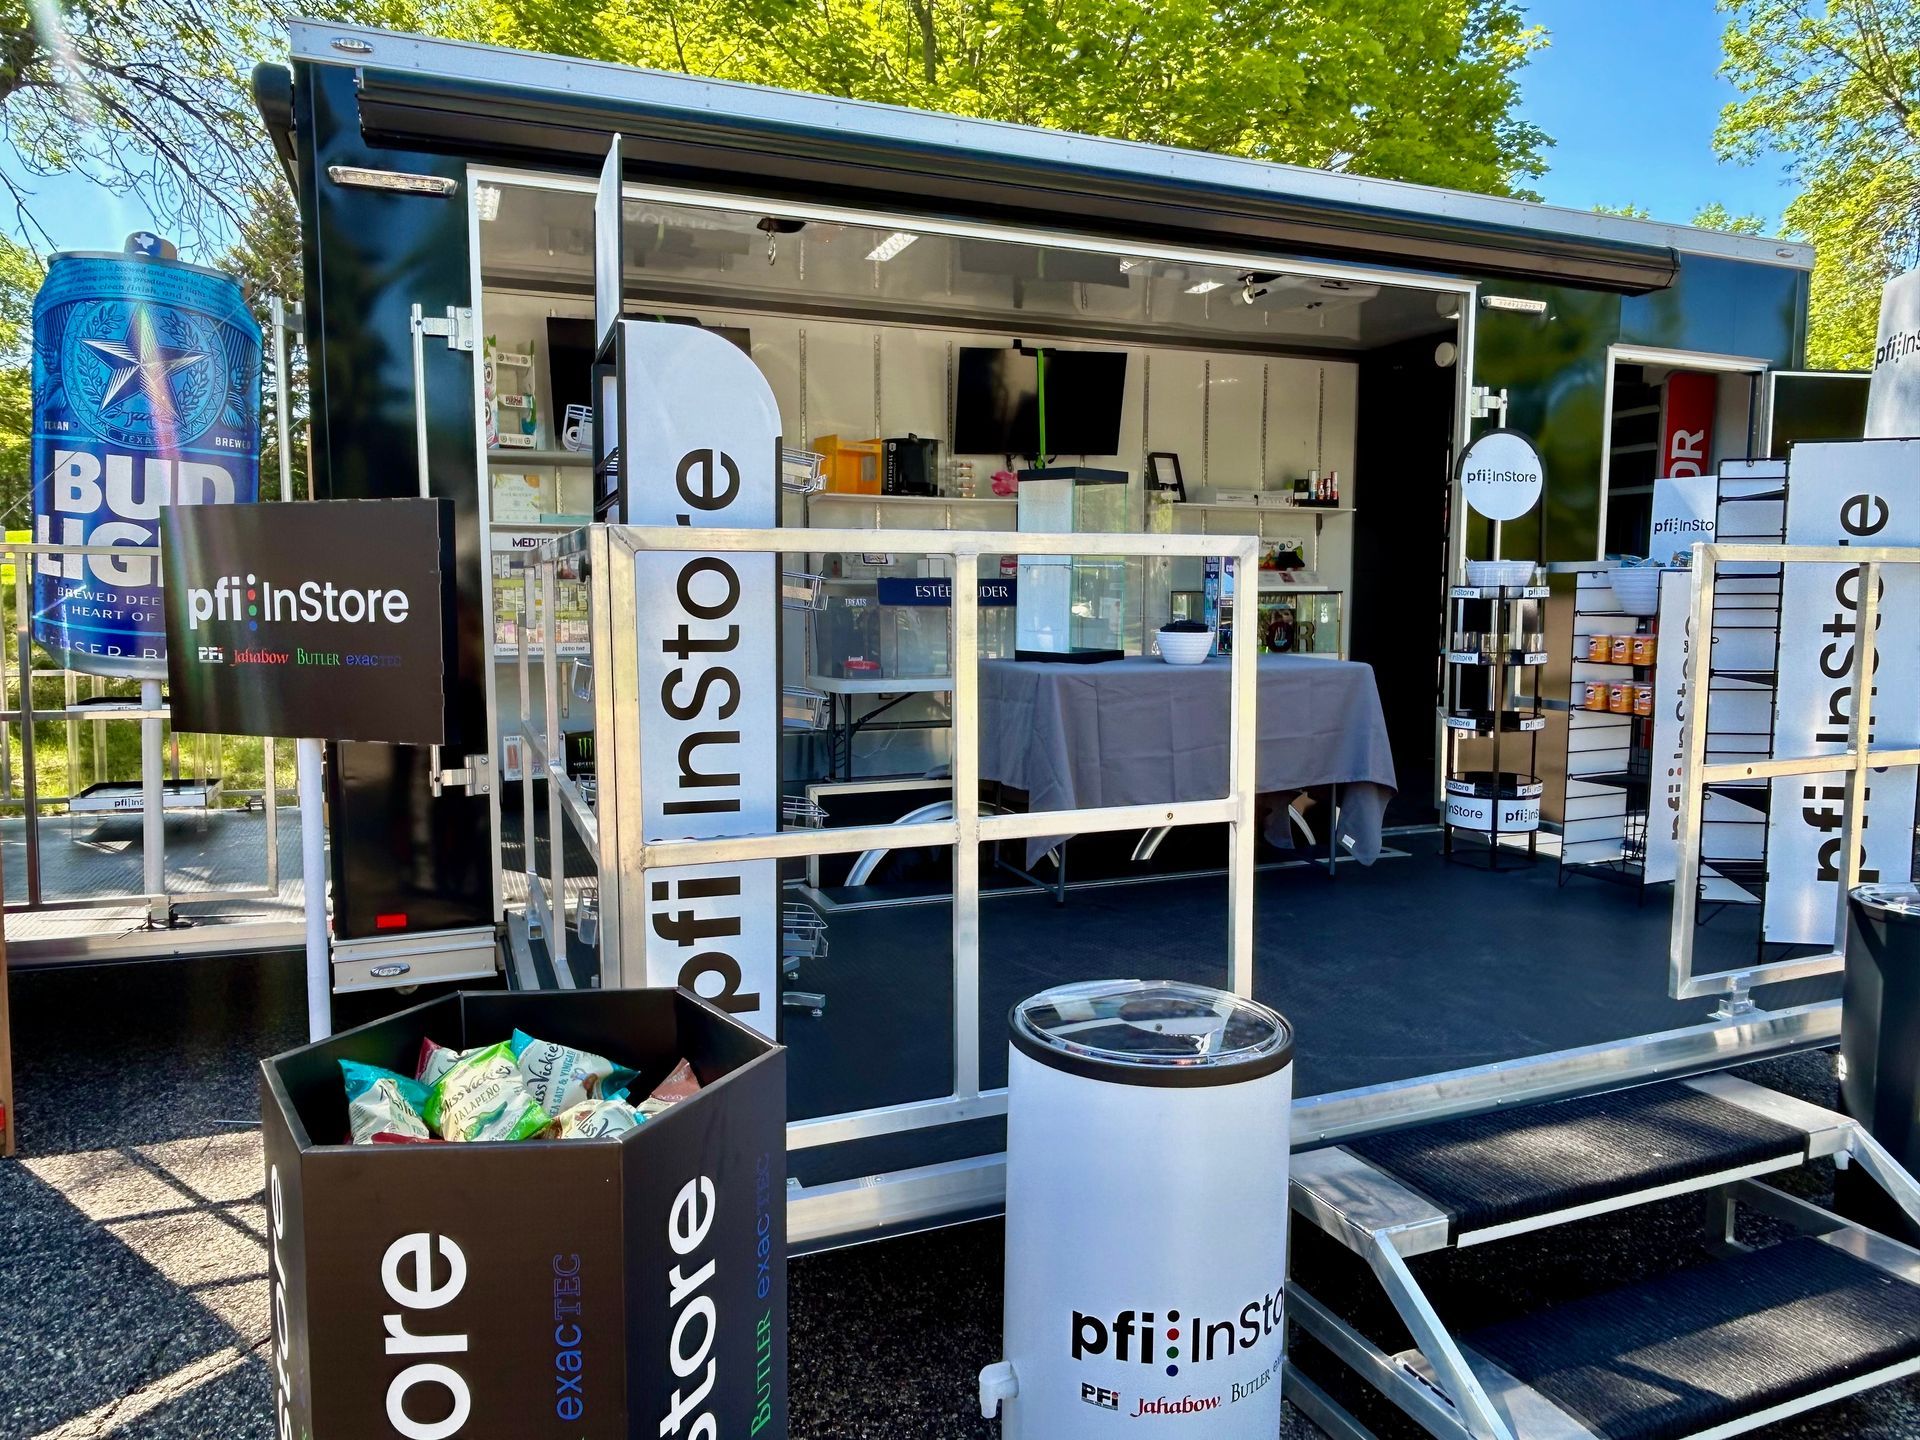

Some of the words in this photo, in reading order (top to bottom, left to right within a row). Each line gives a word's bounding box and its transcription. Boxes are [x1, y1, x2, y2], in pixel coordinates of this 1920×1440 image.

[122, 433, 160, 445] TEXA
[54, 450, 236, 520] BUD
[36, 514, 166, 588] LIG
[57, 586, 118, 604] BREWED
[71, 605, 124, 621] HEART
[131, 611, 158, 623] OF
[263, 580, 410, 625] InStore
[1816, 494, 1889, 743] InStoe
[381, 1231, 471, 1440] ore
[553, 1252, 584, 1421] exacTEC
